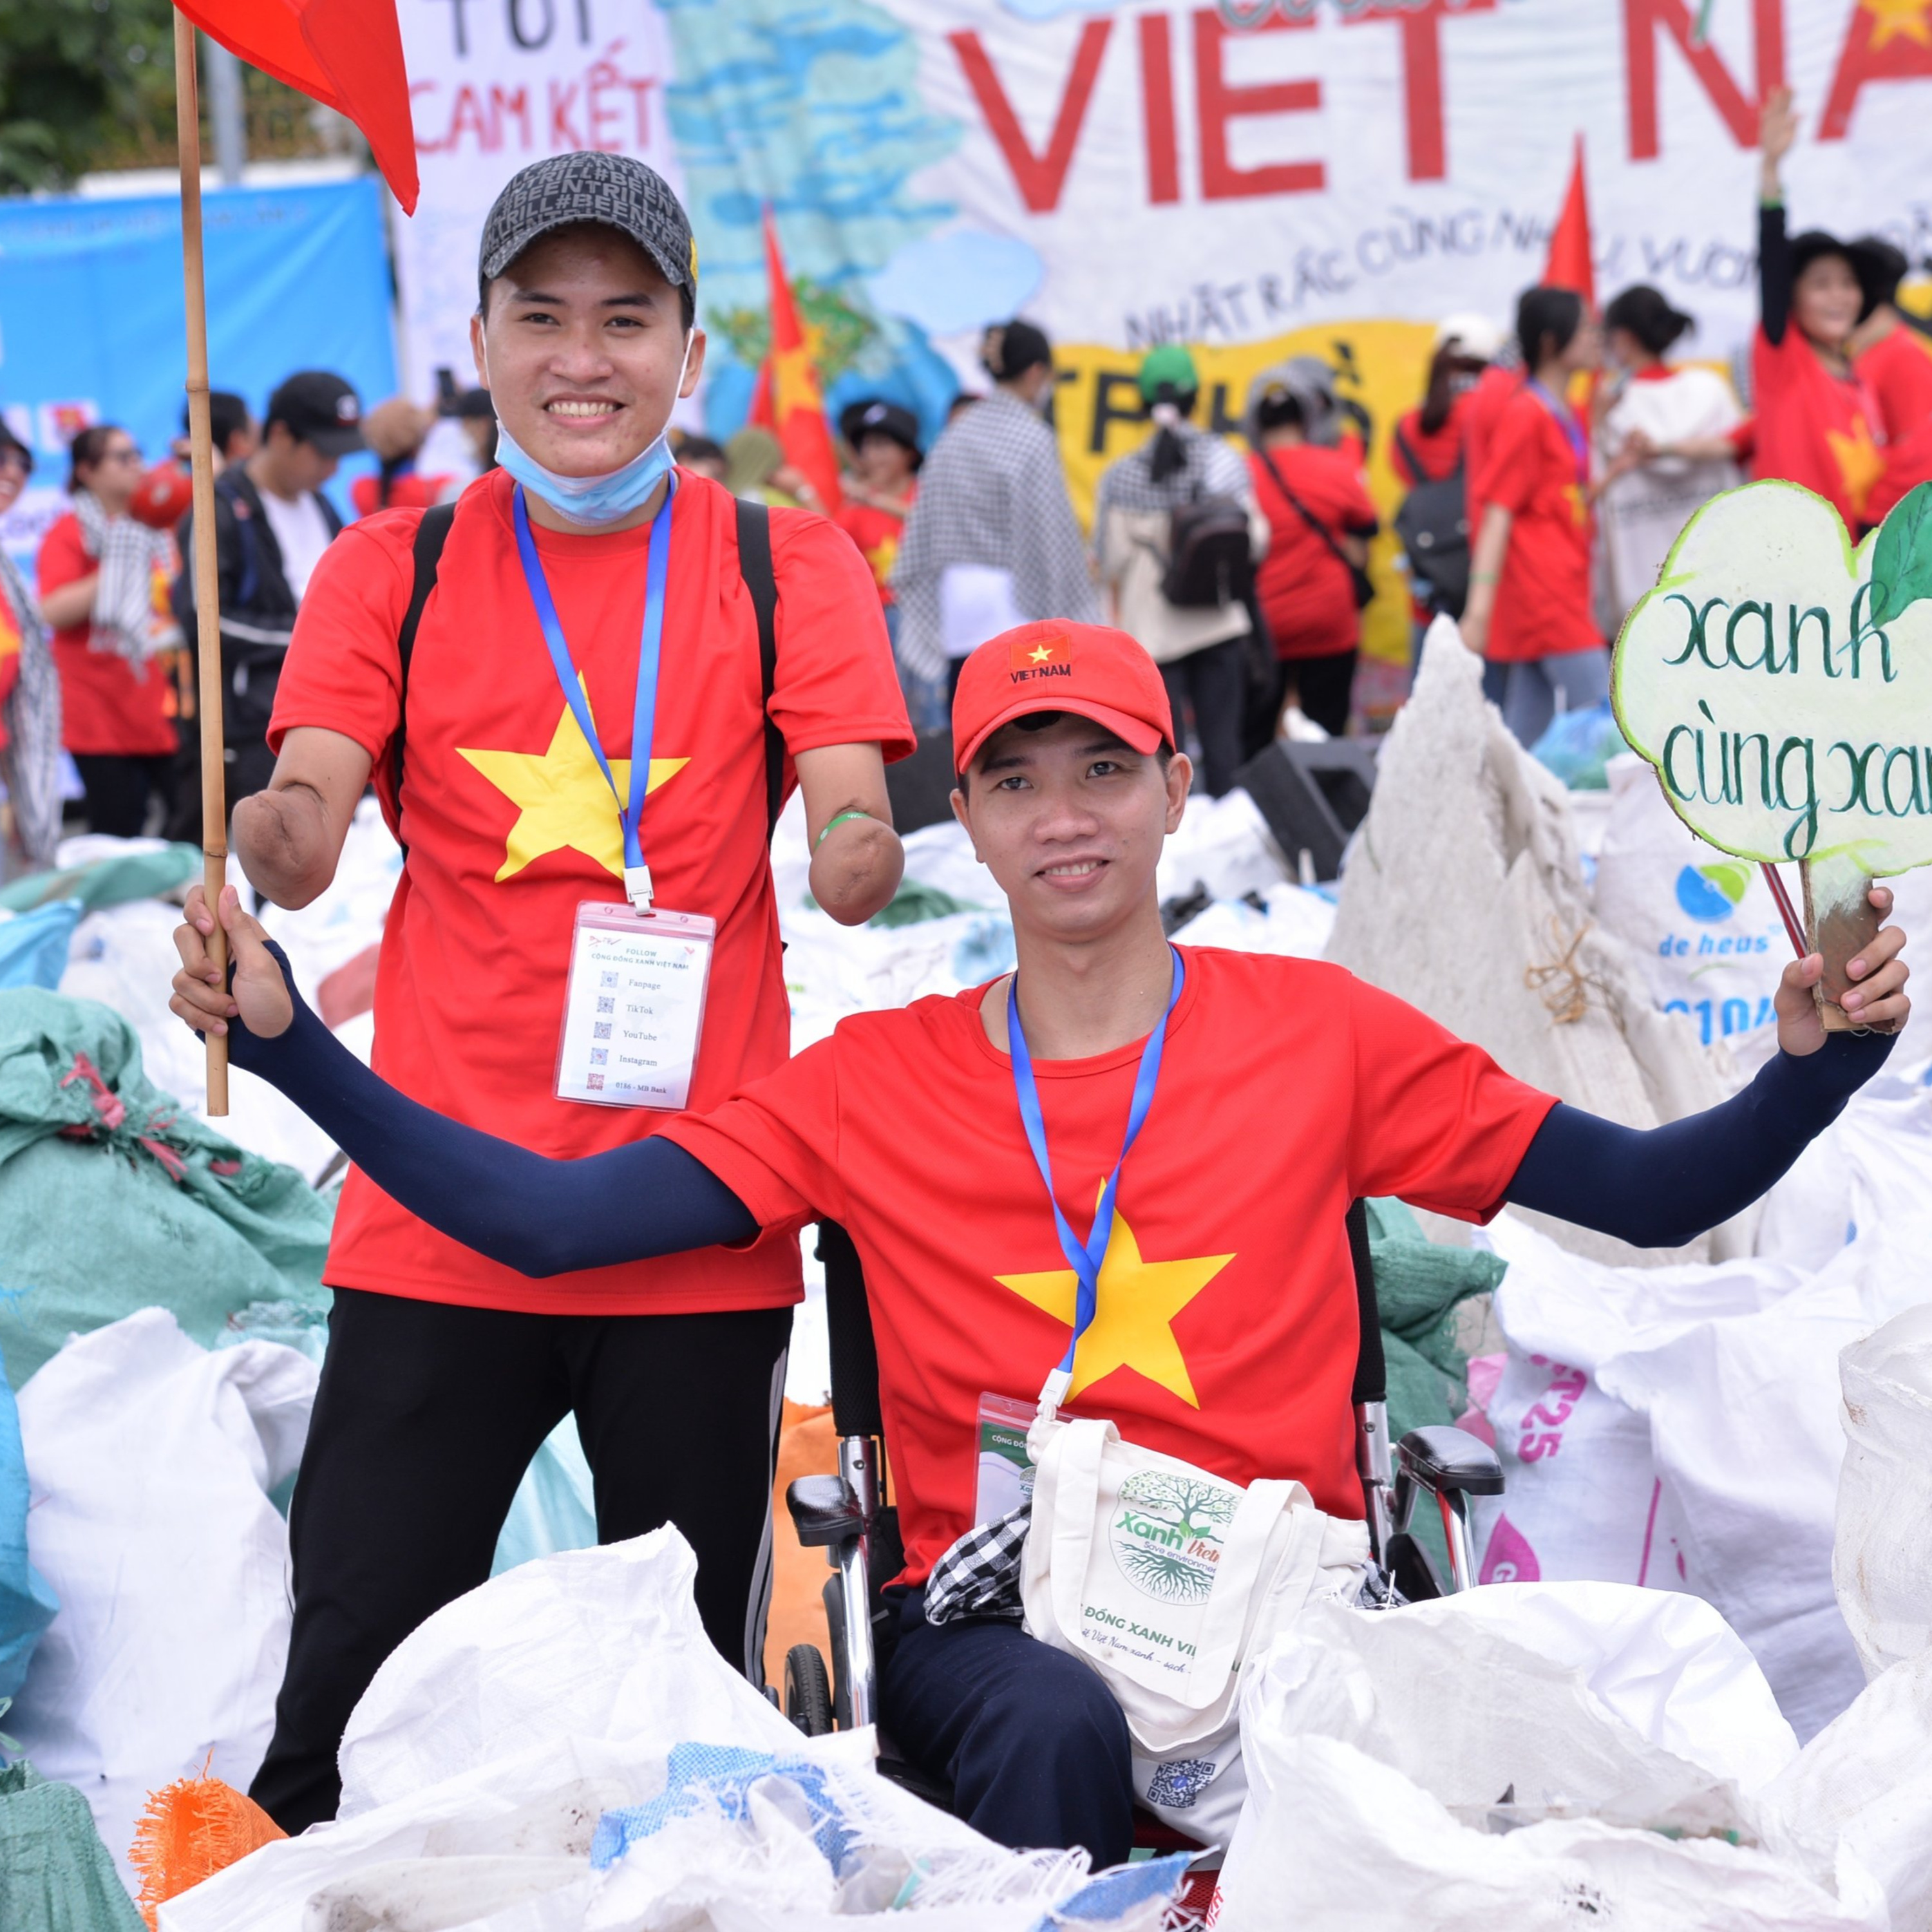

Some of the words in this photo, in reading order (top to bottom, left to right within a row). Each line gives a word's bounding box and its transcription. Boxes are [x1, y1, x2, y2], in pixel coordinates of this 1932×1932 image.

[410, 80, 531, 155] CAM
[547, 36, 659, 153] KẾT
[1662, 581, 1898, 683] xanh
[1663, 699, 1820, 860] cùng
[626, 948, 657, 957] FOLLOW
[1659, 934, 1690, 957] de
[1698, 933, 1768, 954] heus
[629, 979, 661, 990] Fanpage
[626, 1004, 654, 1015] TikTok
[1664, 998, 1777, 1046] 10
[623, 1030, 658, 1041] YouTube
[619, 1055, 658, 1066] Instagram
[992, 1434, 1012, 1446] CỘNG
[1115, 1511, 1184, 1551] Xanh
[1143, 1541, 1165, 1554] Save
[1084, 1606, 1126, 1629] ĐỒNG
[1127, 1622, 1174, 1648] XANH
[1108, 1636, 1128, 1651] Nam
[1130, 1649, 1154, 1662] xanh
